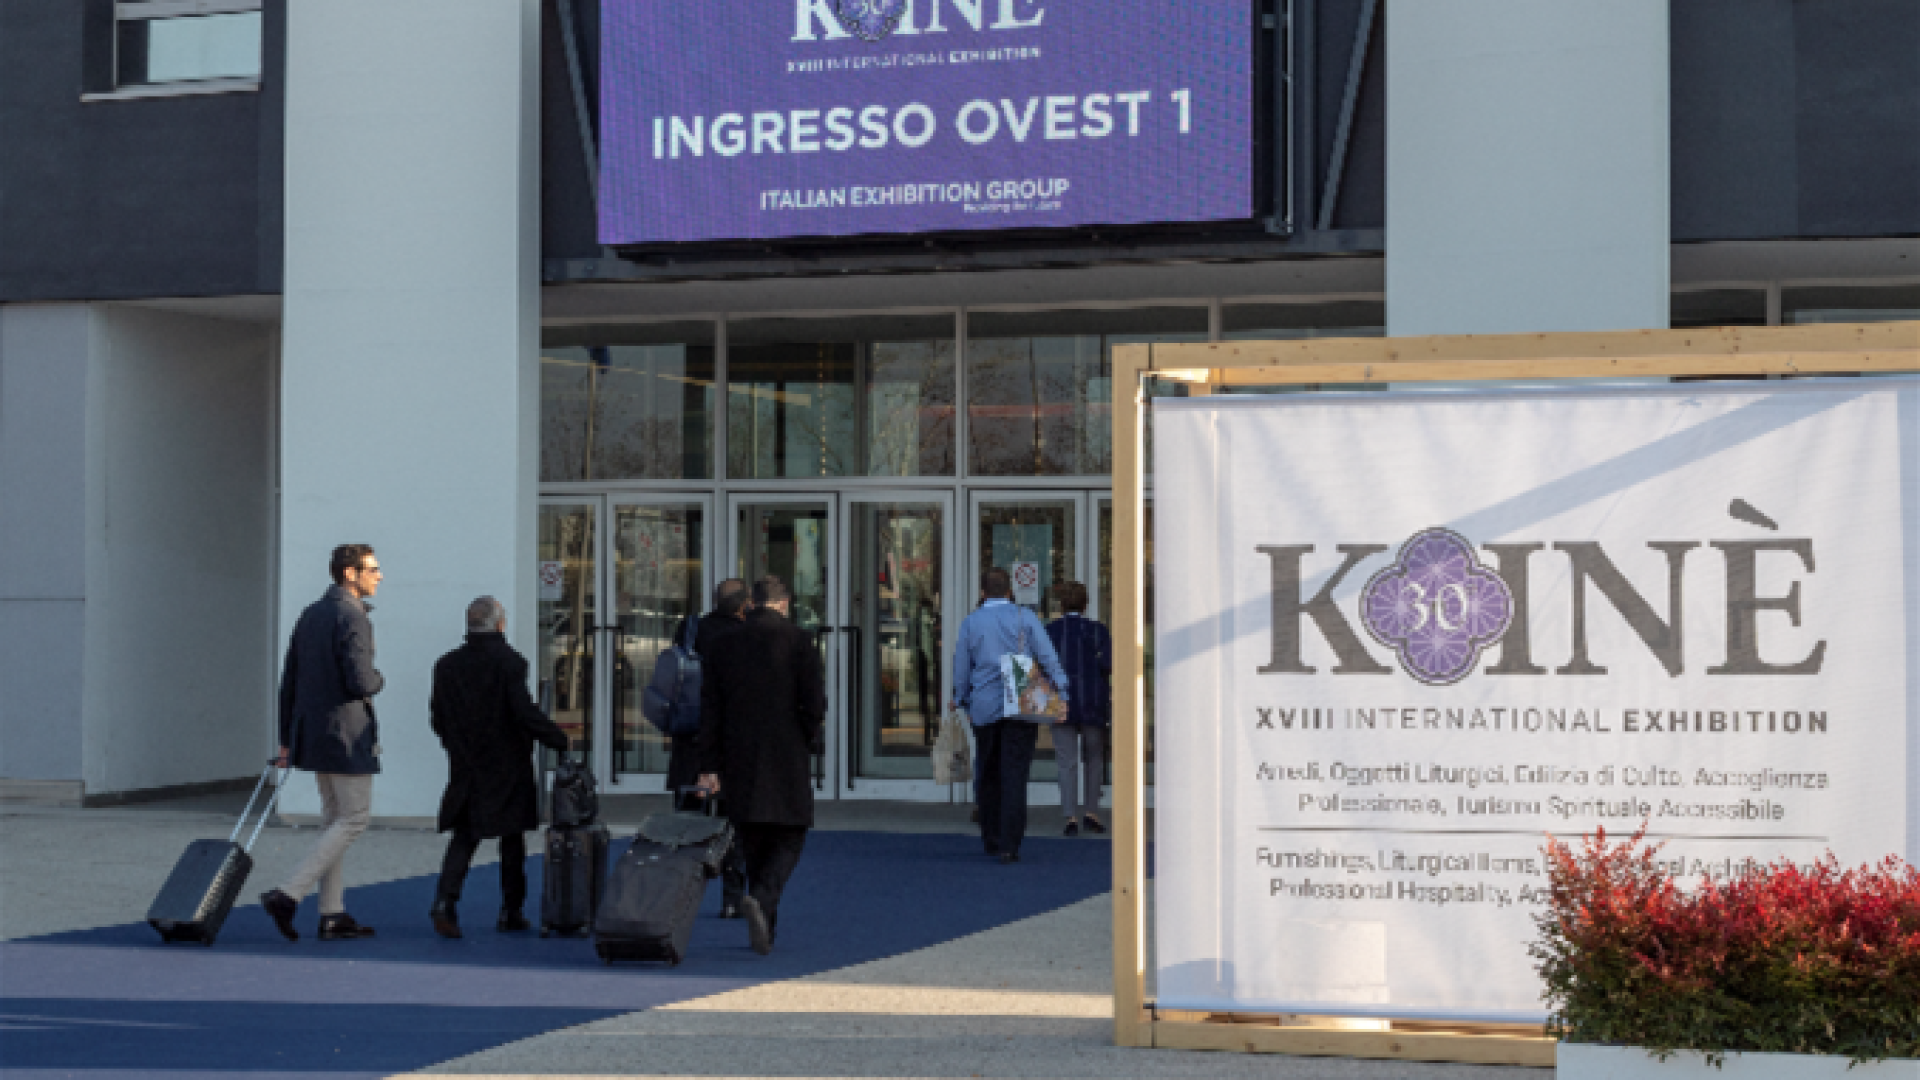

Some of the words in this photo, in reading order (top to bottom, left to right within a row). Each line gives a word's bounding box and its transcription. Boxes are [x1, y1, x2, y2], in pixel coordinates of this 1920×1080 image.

[827, 52, 946, 70] INTERNATIONAL
[949, 47, 1042, 64] EXHIBITION
[651, 101, 937, 160] INGRESSO
[955, 90, 1151, 145] OVEST
[1170, 87, 1192, 134] 1
[759, 187, 846, 211] ITALIAN
[850, 181, 981, 206] EXHIBITION
[986, 178, 1070, 200] GROUP
[1255, 706, 1335, 730] XVIII
[1343, 706, 1612, 733] INTERNATIONAL
[1621, 708, 1828, 733] EXHIBITION
[1329, 761, 1410, 786] Oggetti
[1595, 764, 1615, 786] di
[1547, 795, 1652, 820] Spirituale
[1655, 799, 1786, 821] Accessibile
[1378, 849, 1470, 876] Liturgical
